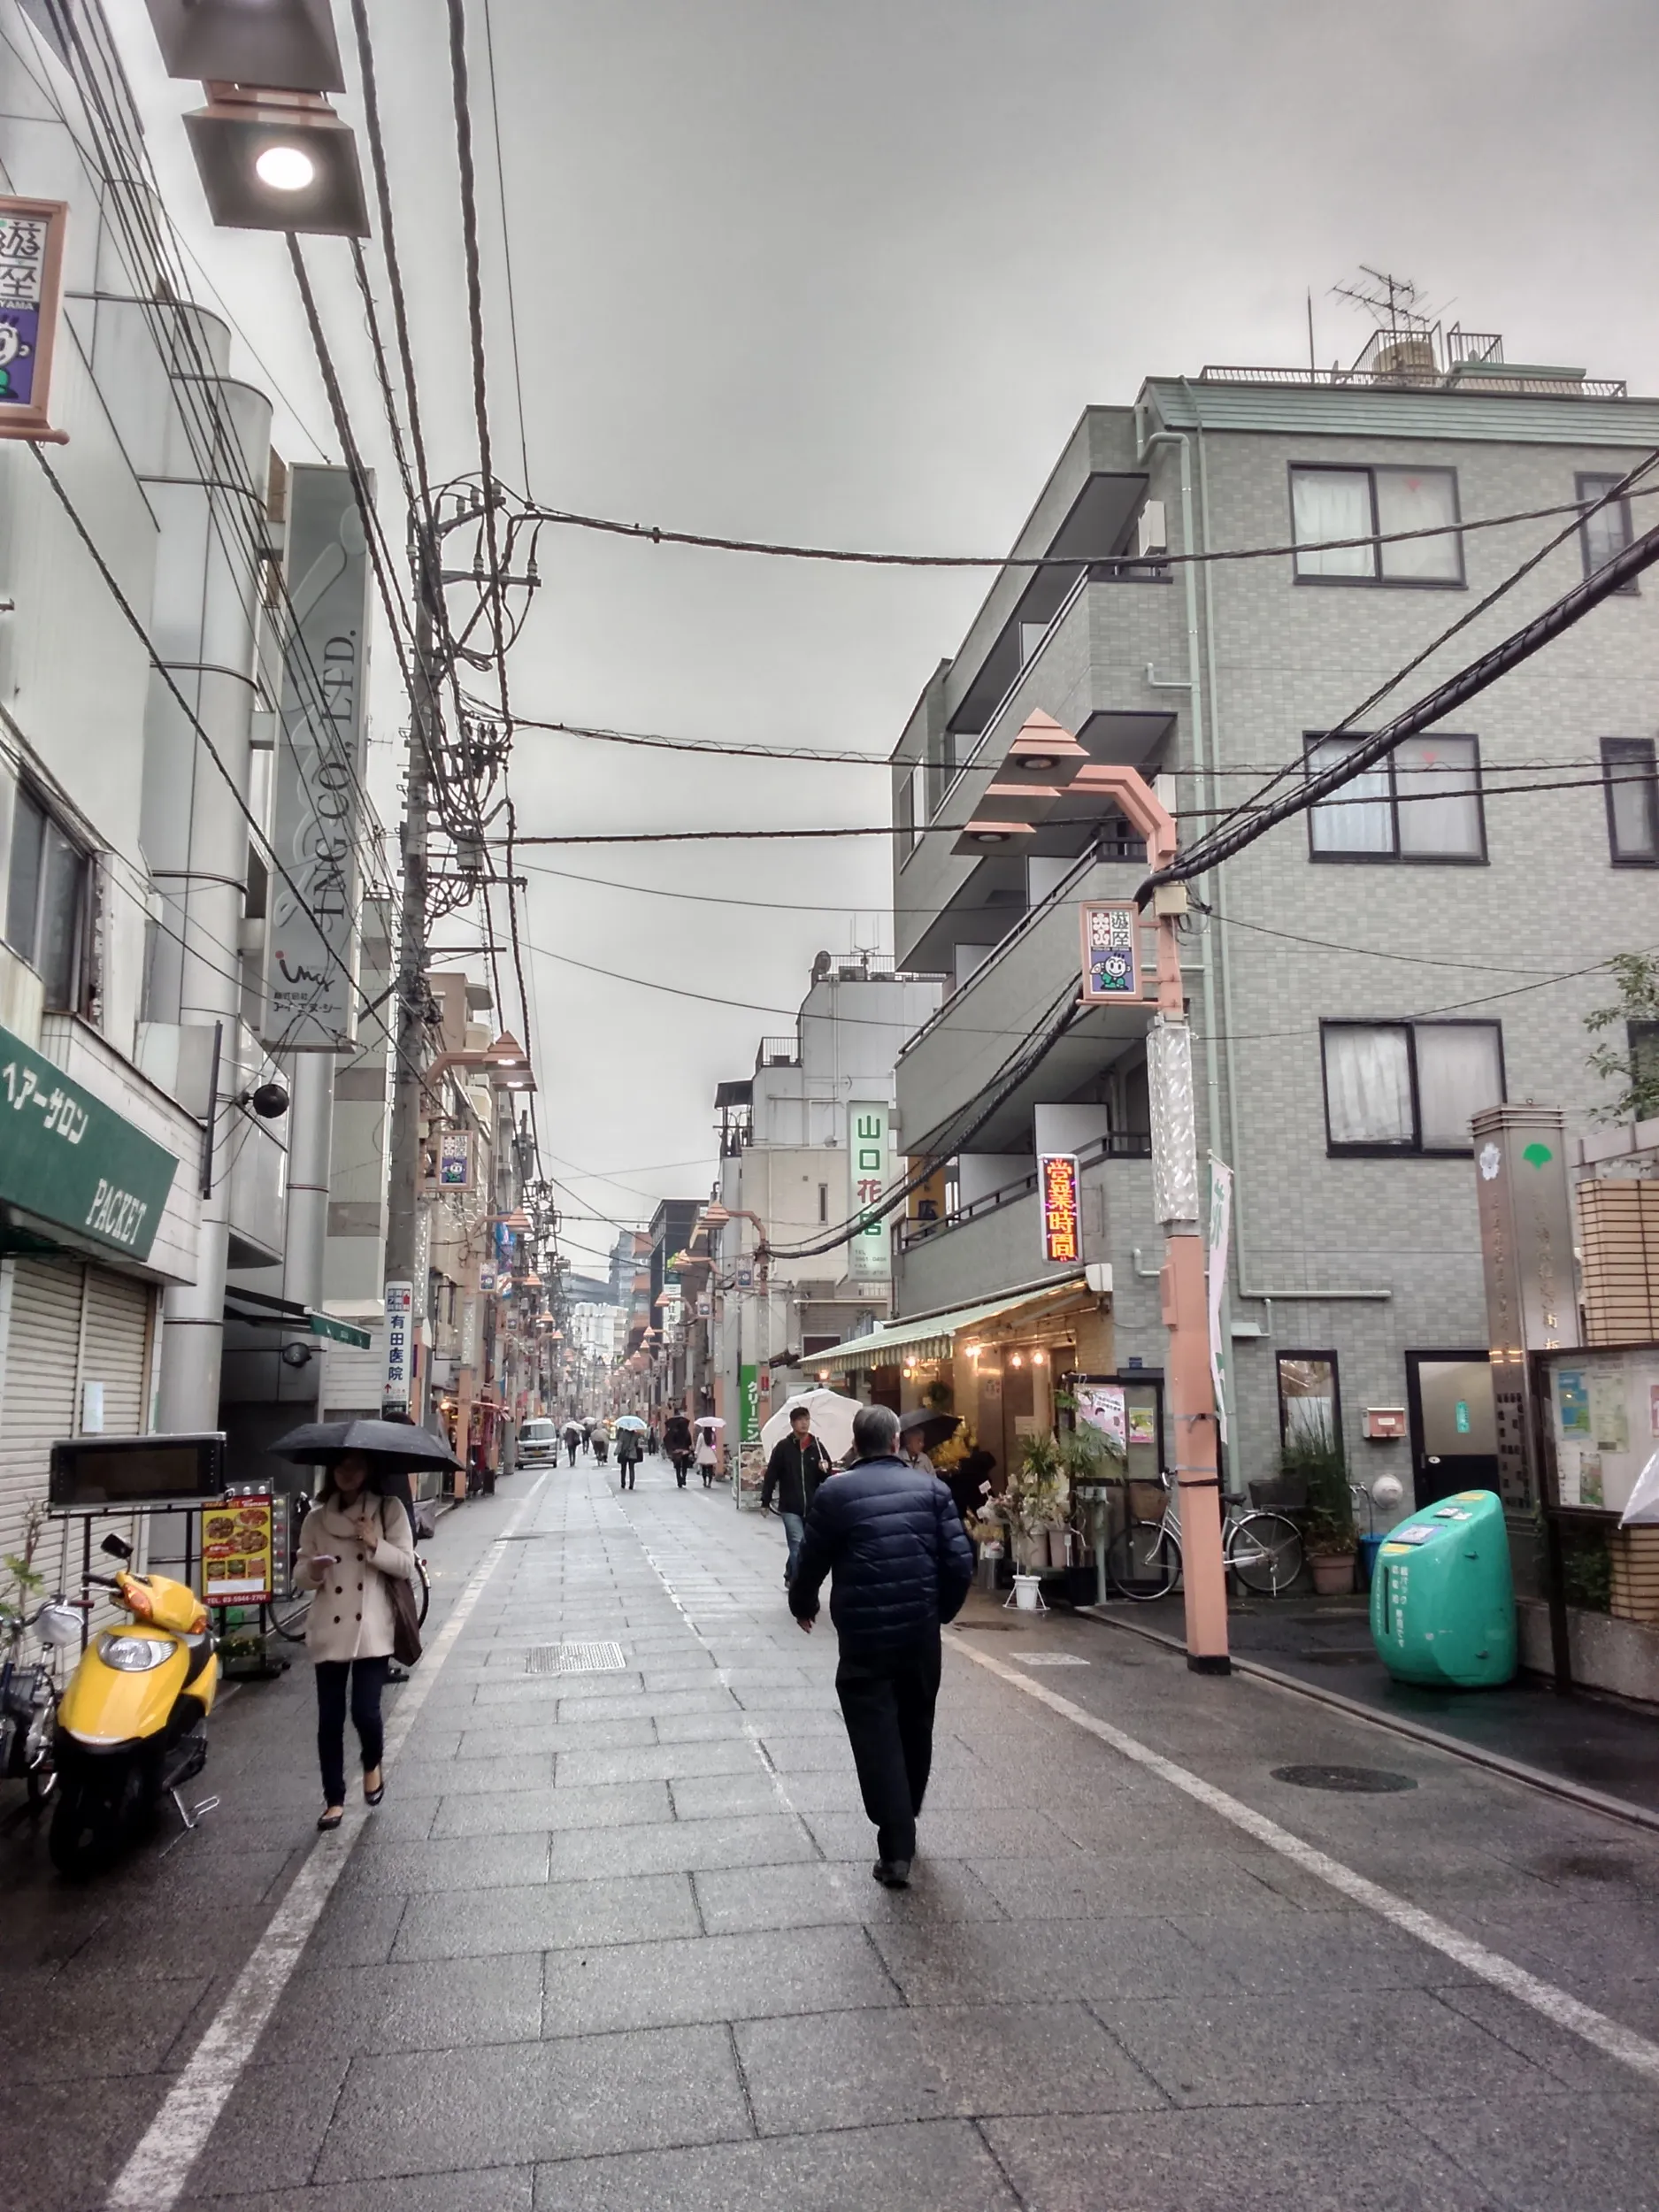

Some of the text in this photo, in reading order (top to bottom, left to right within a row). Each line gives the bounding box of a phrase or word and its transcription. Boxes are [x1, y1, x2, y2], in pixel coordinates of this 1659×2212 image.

[3, 1062, 88, 1144] ヘアーサロン
[85, 1178, 148, 1245] PACKET
[856, 1115, 882, 1236] 山口花店
[1047, 1158, 1075, 1258] 営業時間
[388, 1315, 405, 1381] 有田医院
[748, 1381, 759, 1441] クリーニン
